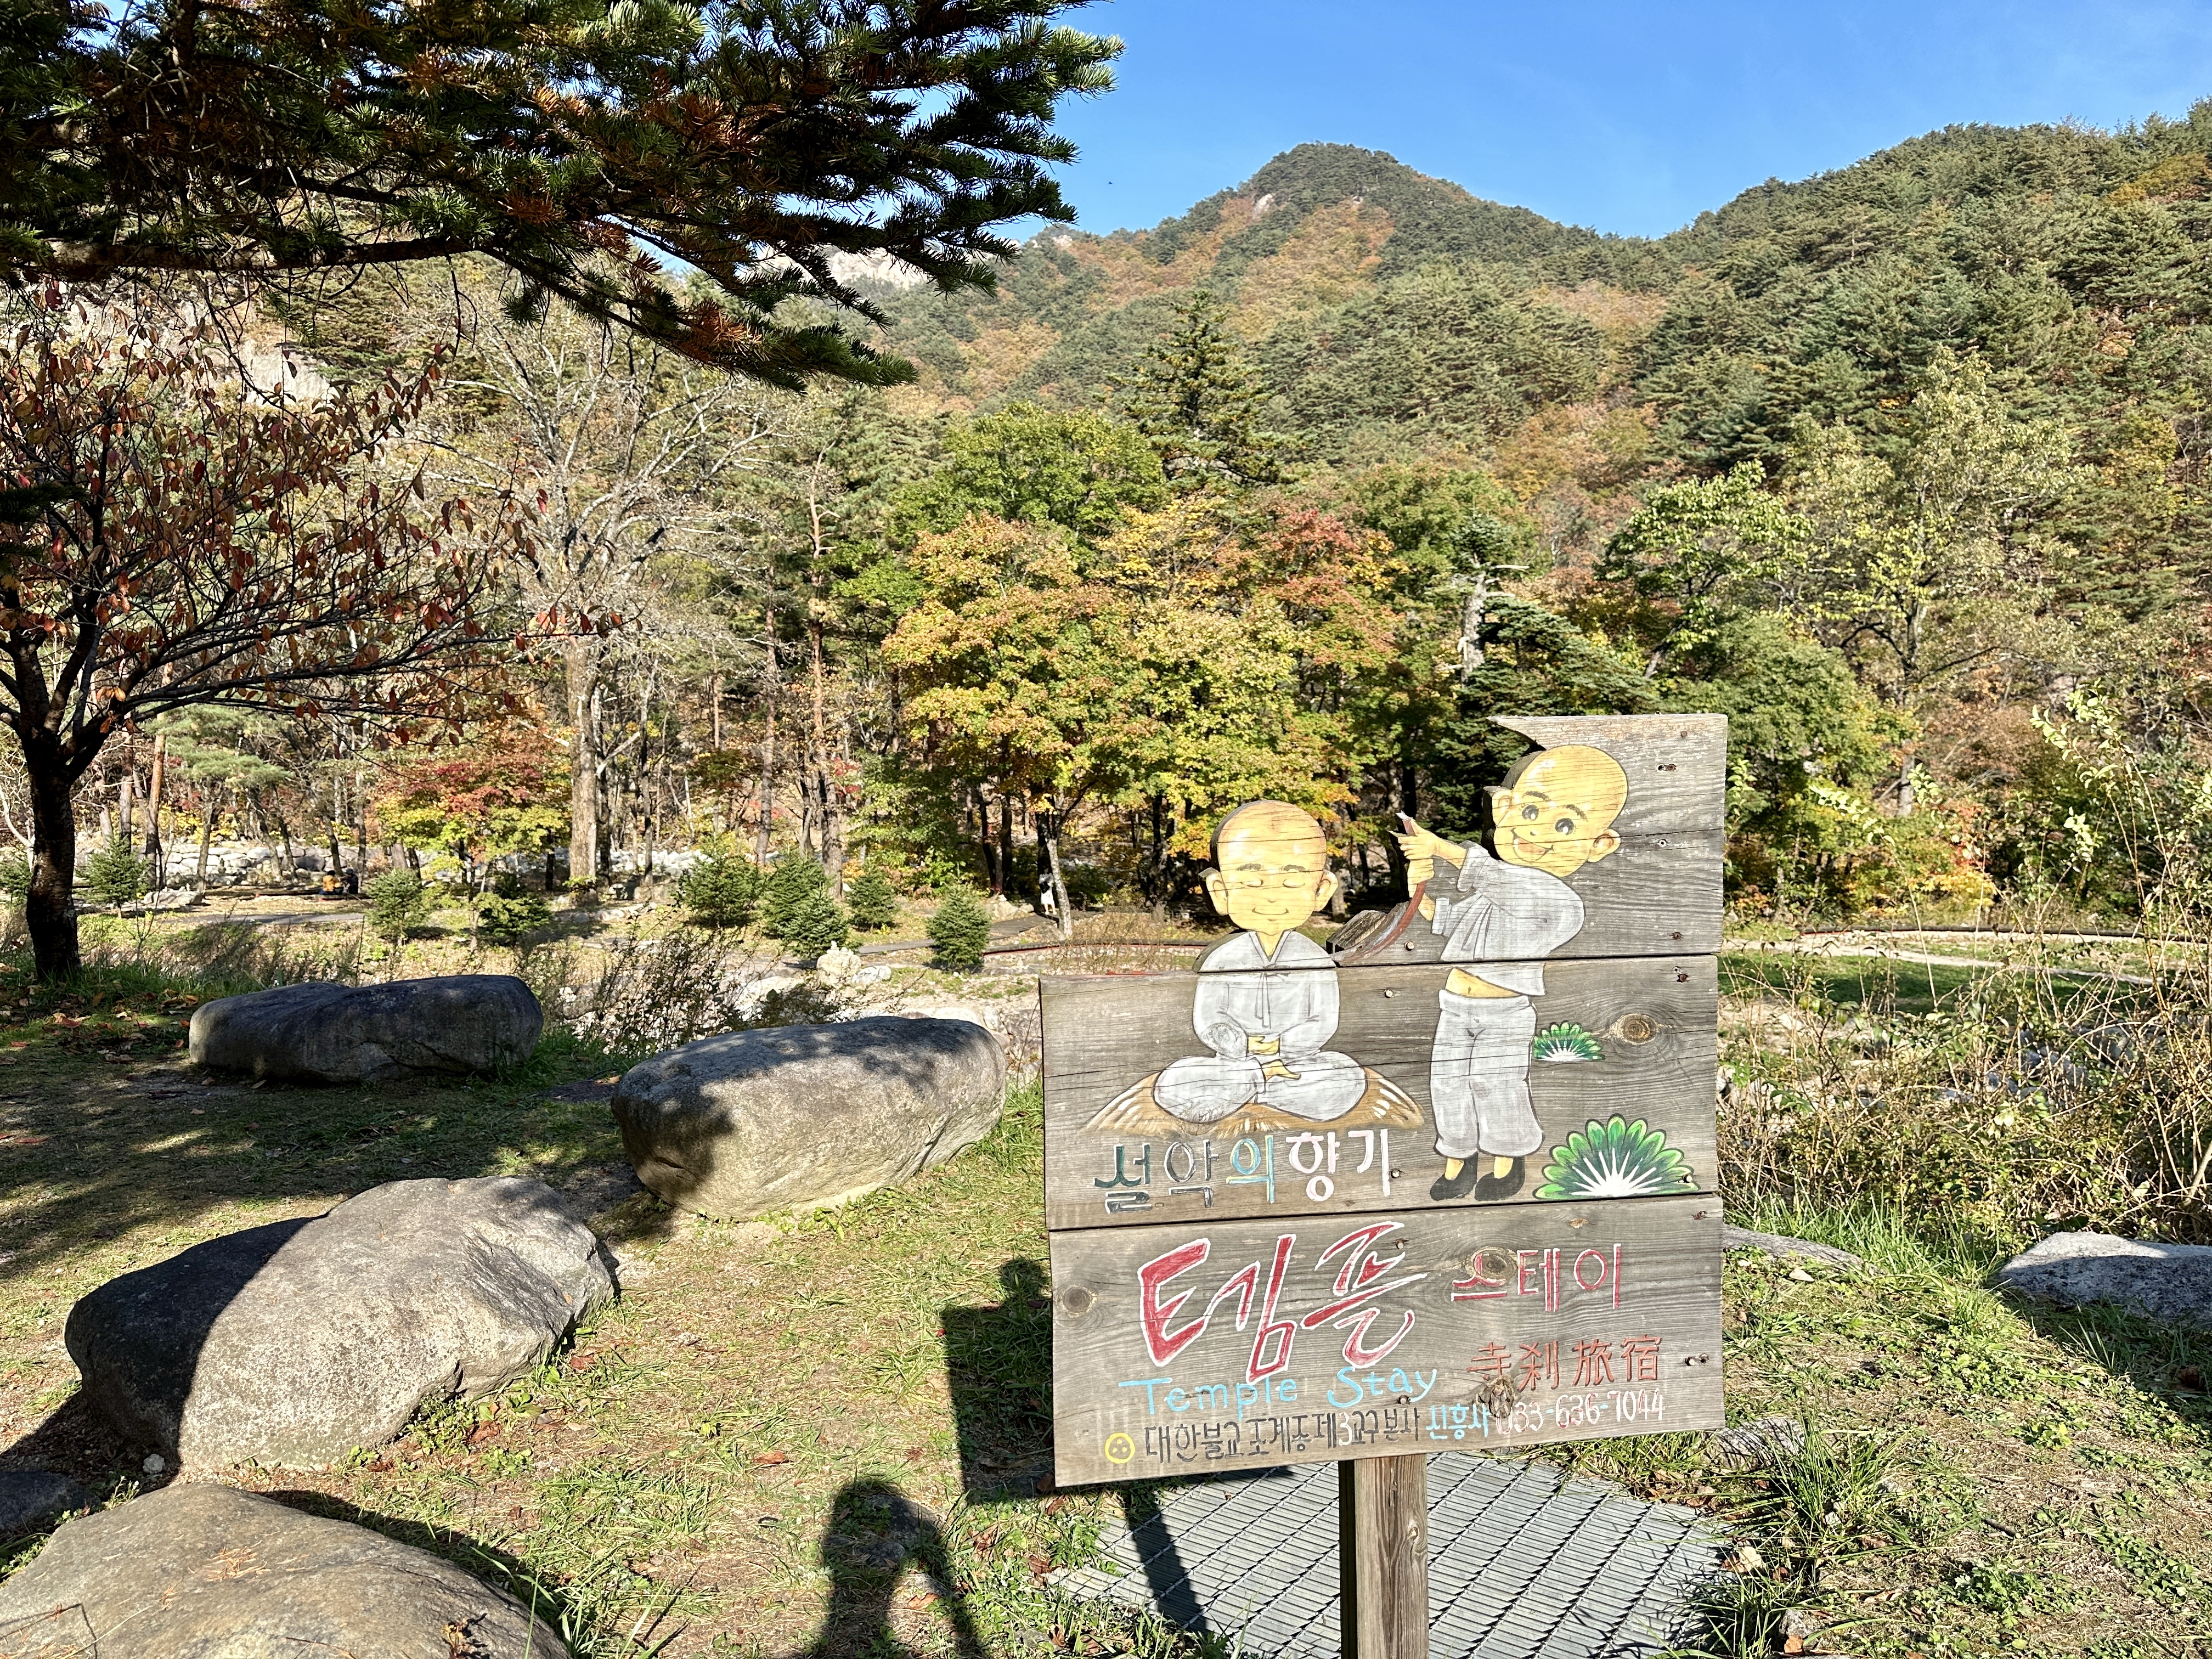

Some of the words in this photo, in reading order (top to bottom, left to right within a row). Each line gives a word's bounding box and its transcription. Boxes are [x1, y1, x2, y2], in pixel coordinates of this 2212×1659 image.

[1451, 1243, 1622, 1312] 스테이
[1466, 1334, 1663, 1392] 寺刹旅宿
[1118, 1376, 1299, 1420] Temple
[1327, 1366, 1437, 1408] Stay
[1426, 1402, 1492, 1440] 신흥사
